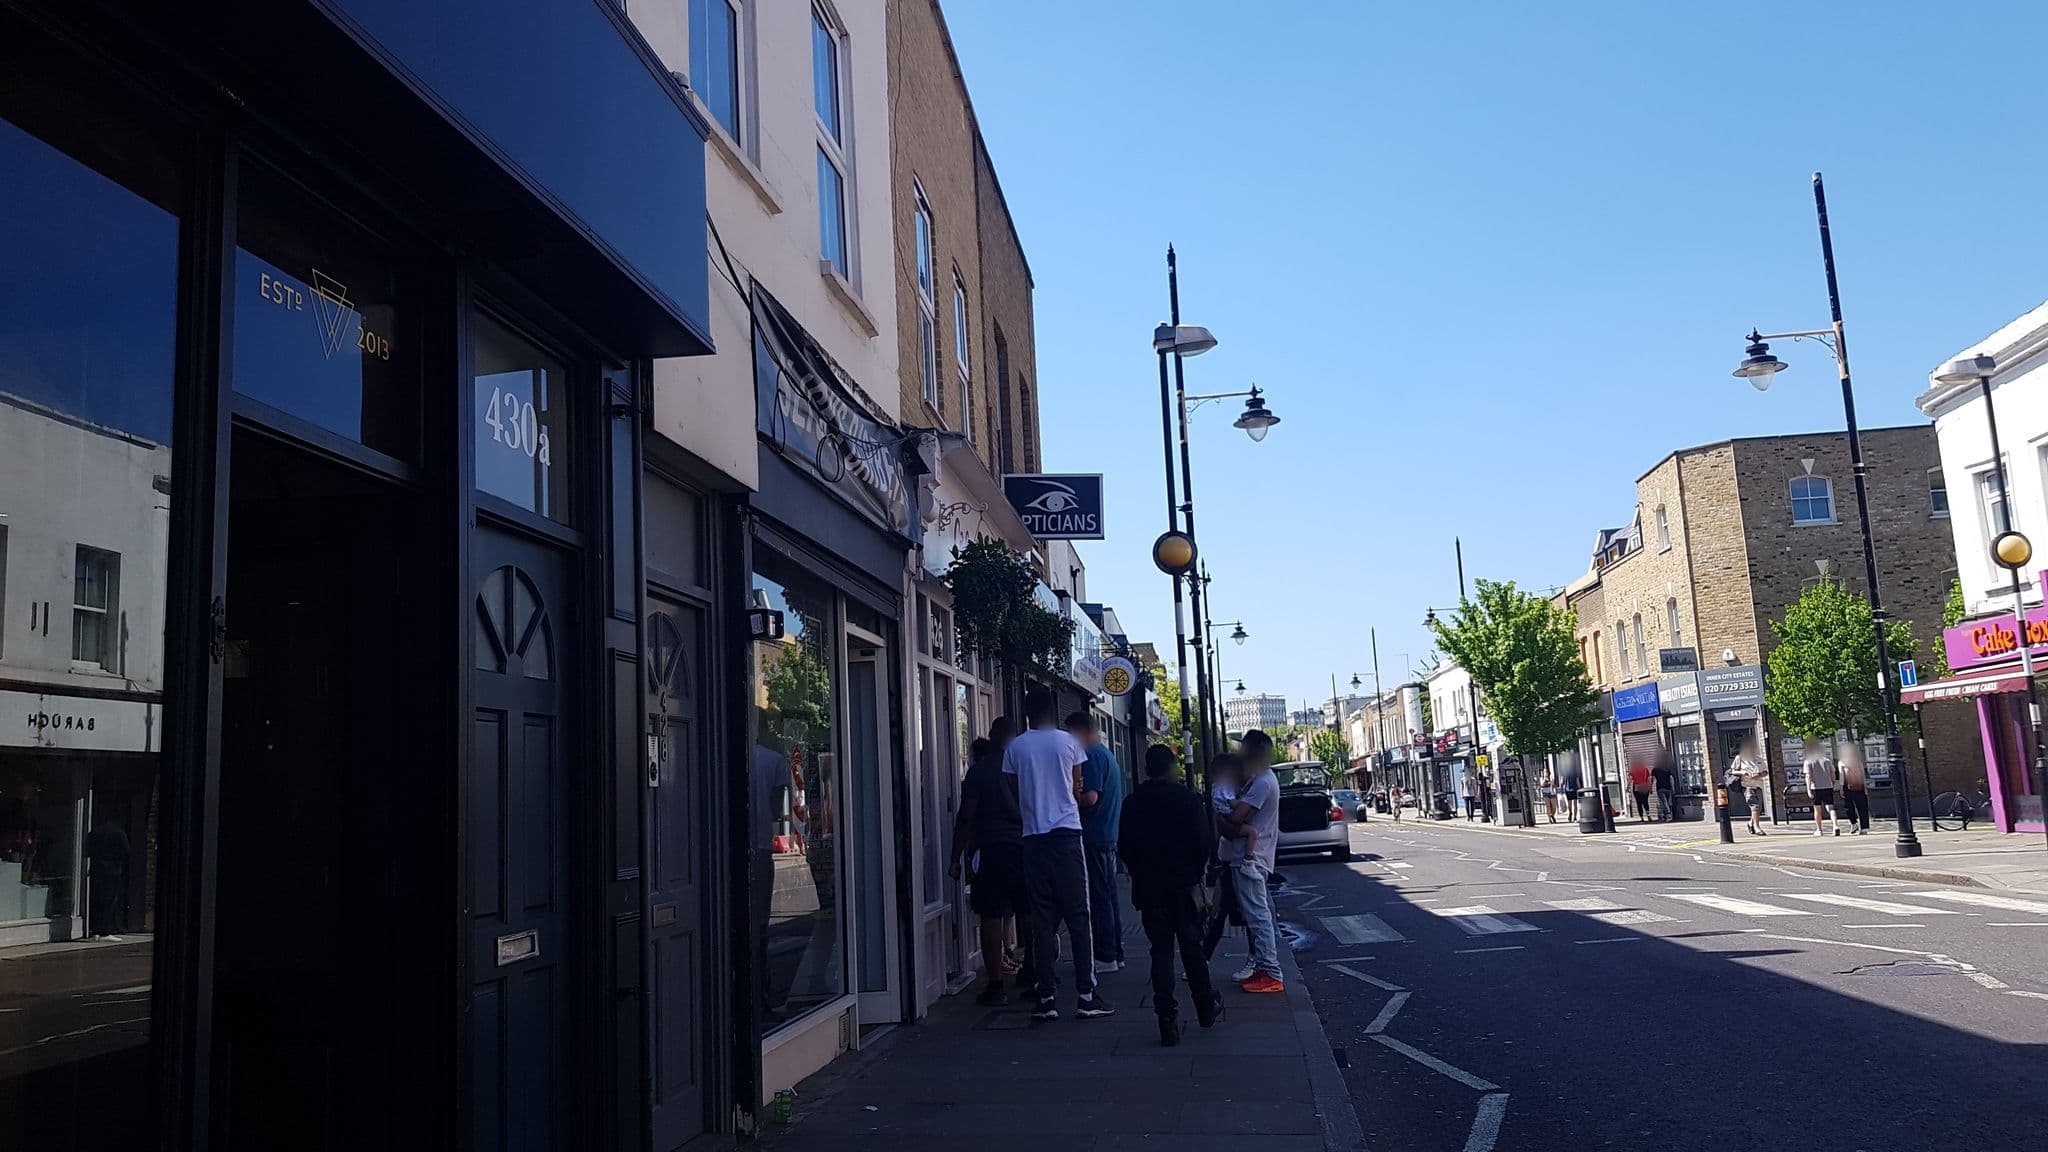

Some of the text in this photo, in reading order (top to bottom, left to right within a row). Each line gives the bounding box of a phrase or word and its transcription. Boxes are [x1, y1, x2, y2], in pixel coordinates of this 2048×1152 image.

[356, 326, 390, 361] 2013
[485, 386, 551, 466] 430a
[1021, 513, 1097, 532] PTICIANS
[1971, 624, 2017, 656] Cake
[1704, 680, 1759, 694] 020 7729 3323
[1733, 671, 1754, 679] ESTATES
